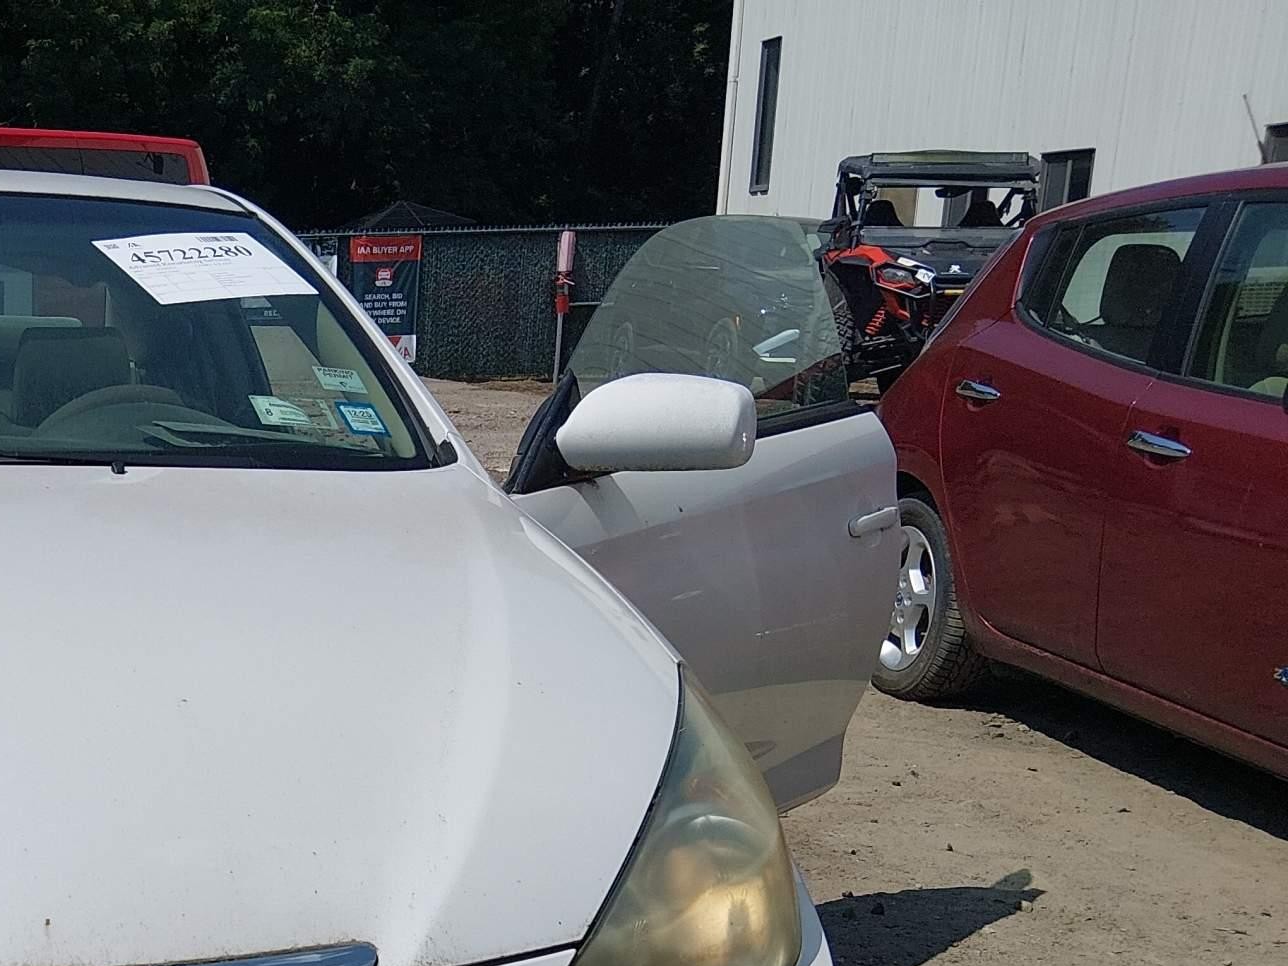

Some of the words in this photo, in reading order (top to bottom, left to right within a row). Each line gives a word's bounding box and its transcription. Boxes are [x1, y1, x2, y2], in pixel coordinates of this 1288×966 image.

[131, 245, 253, 264] 45722280
[372, 245, 398, 254] BUYER
[399, 245, 415, 253] APP
